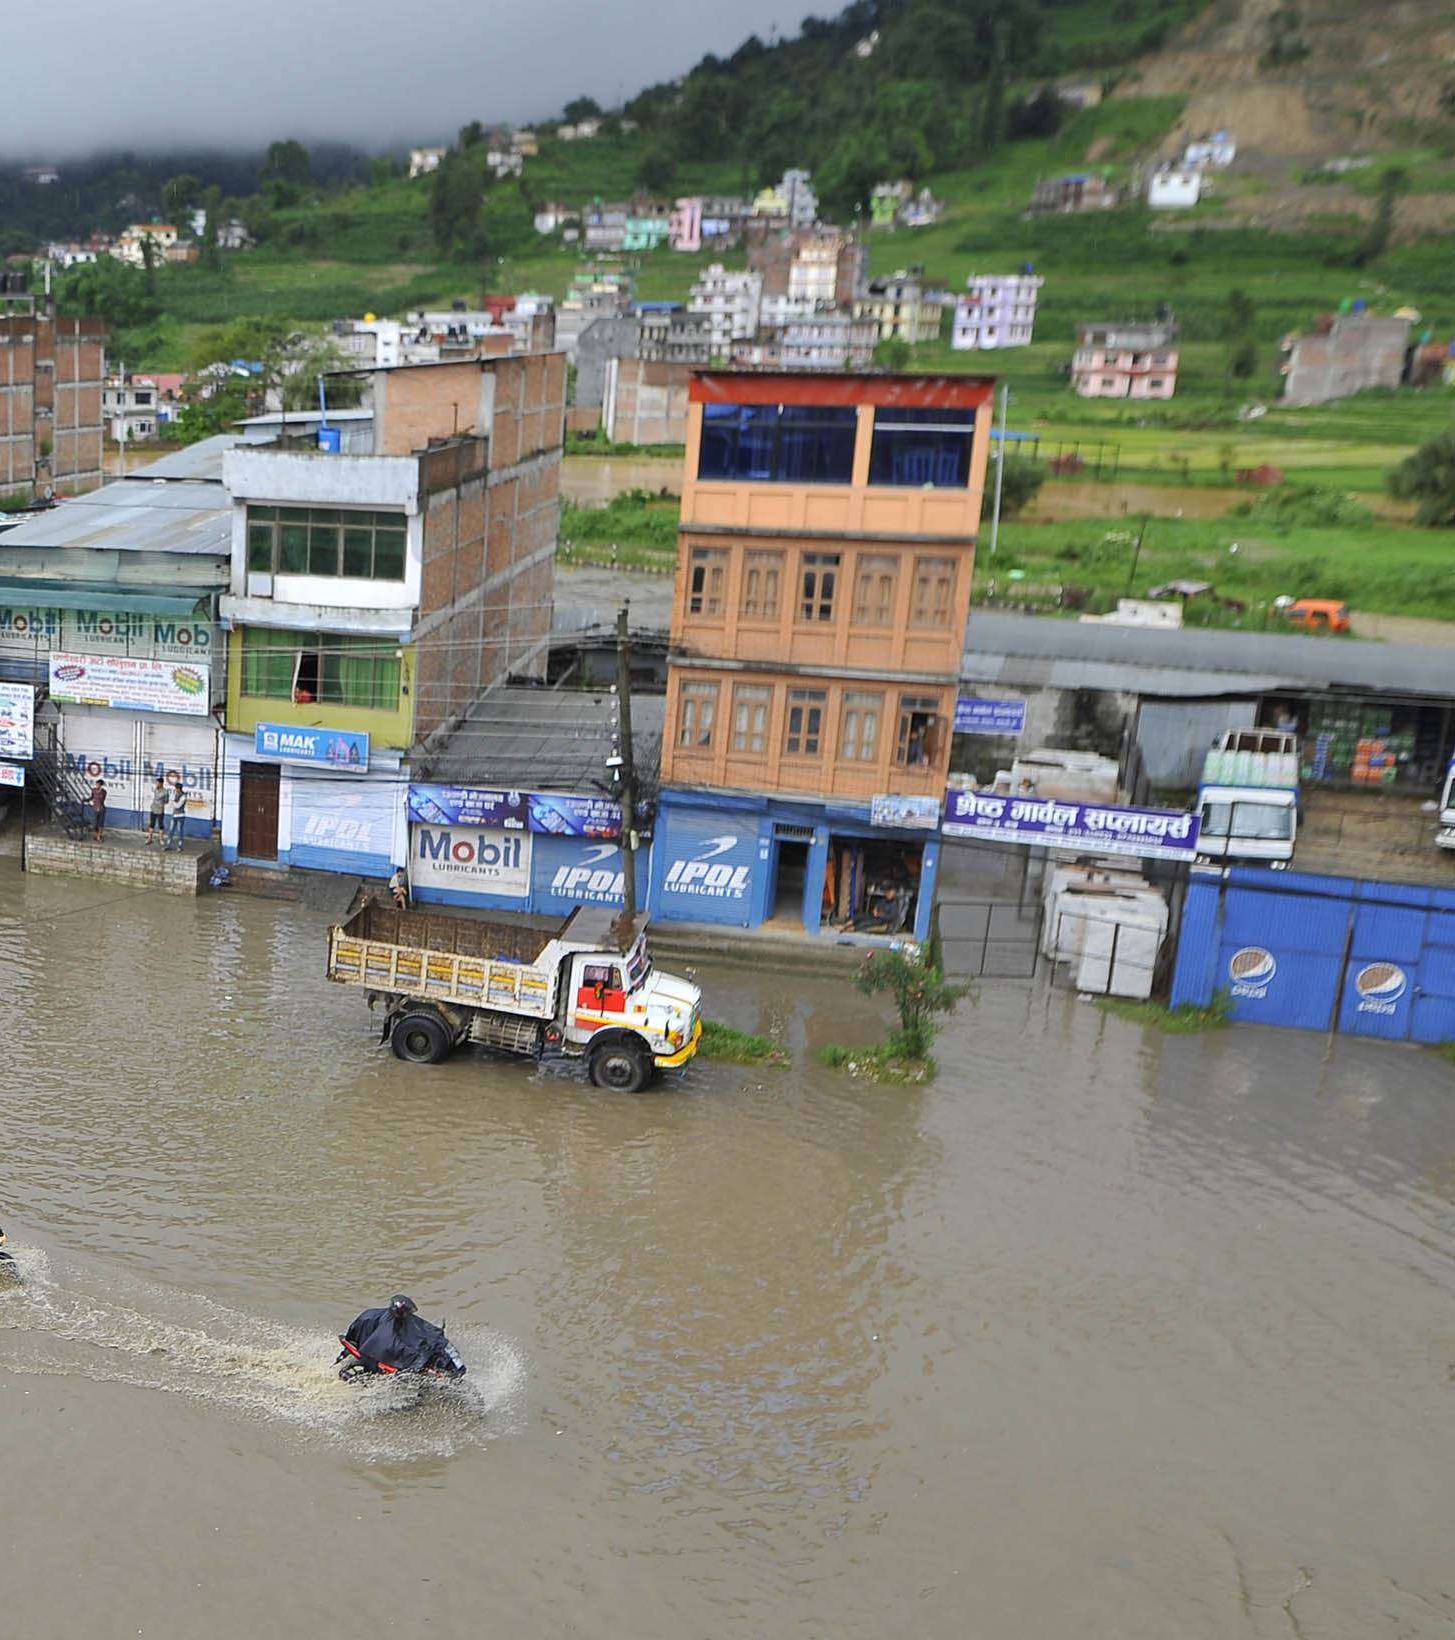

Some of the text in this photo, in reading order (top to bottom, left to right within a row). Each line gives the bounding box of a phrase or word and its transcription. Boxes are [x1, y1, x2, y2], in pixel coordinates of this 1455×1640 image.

[77, 610, 144, 637] Mobil
[280, 733, 316, 750] MAK
[66, 753, 131, 781] Mobil
[420, 829, 521, 868] Mobil
[432, 863, 500, 877] LUBRICANTS
[665, 860, 750, 890] IPOL
[663, 881, 743, 899] LUBRICANTS
